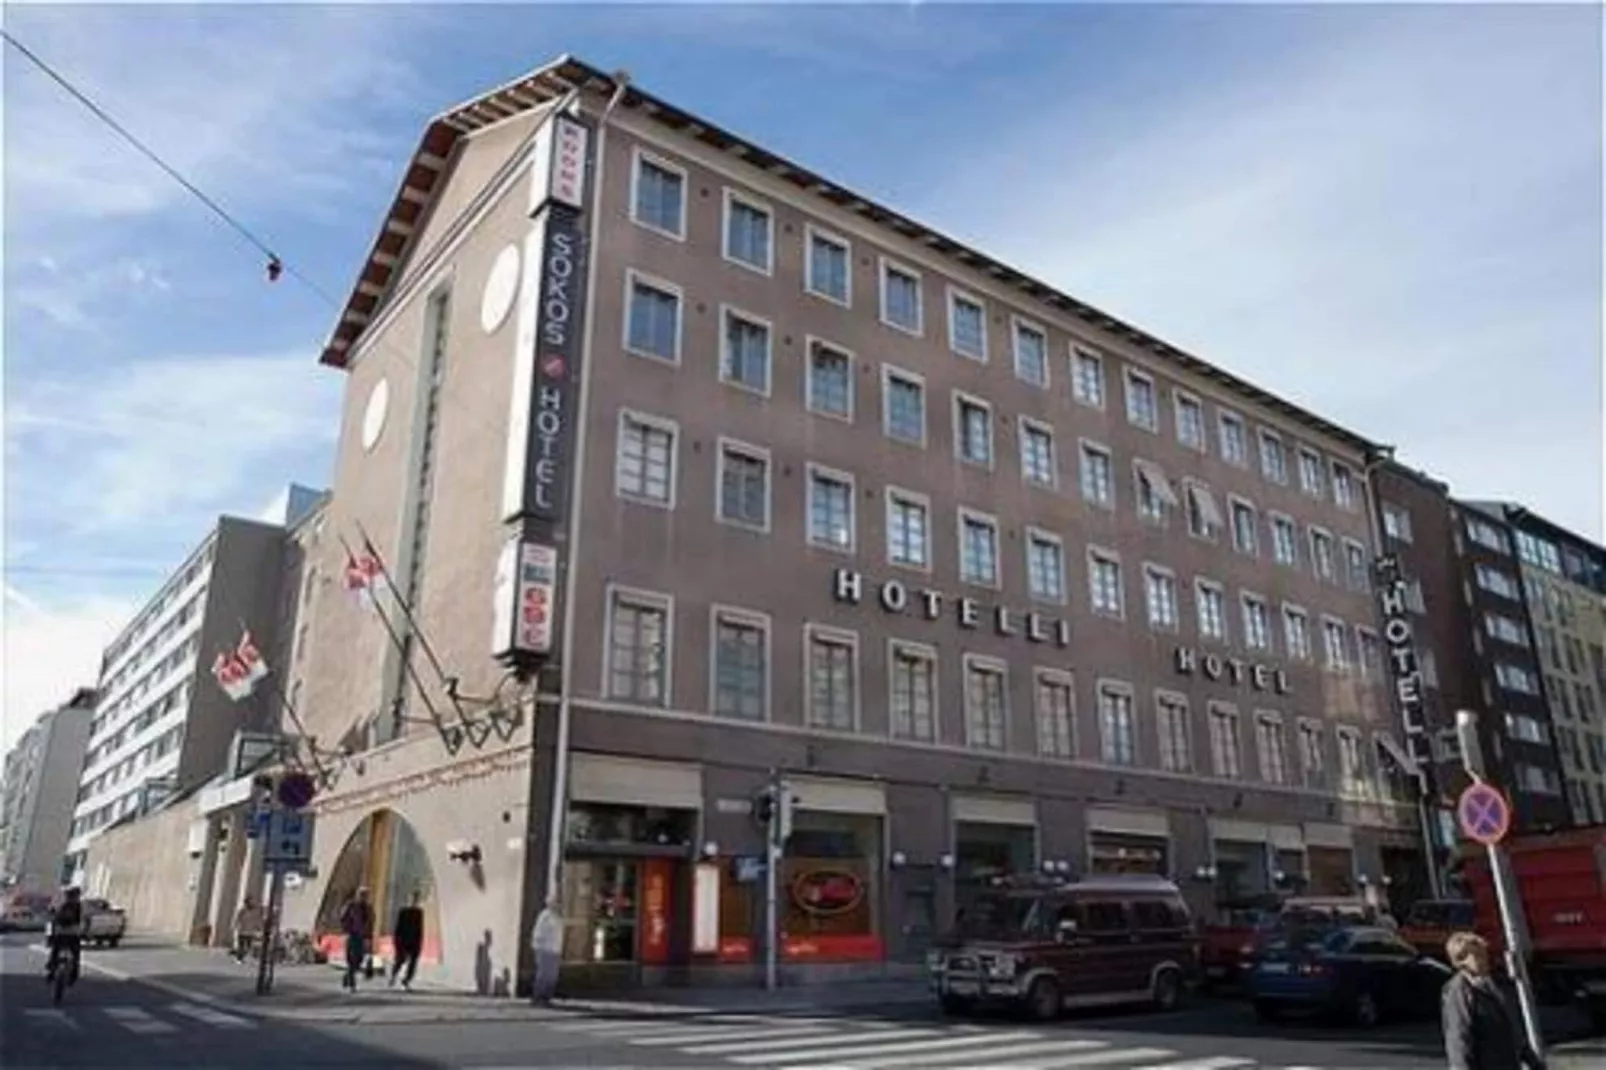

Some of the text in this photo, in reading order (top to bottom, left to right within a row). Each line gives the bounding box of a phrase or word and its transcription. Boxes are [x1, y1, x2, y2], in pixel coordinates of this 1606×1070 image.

[535, 232, 573, 509] SOKOS HOTEL
[834, 568, 1070, 646] HOTELLI
[1175, 646, 1293, 695] HOTEL
